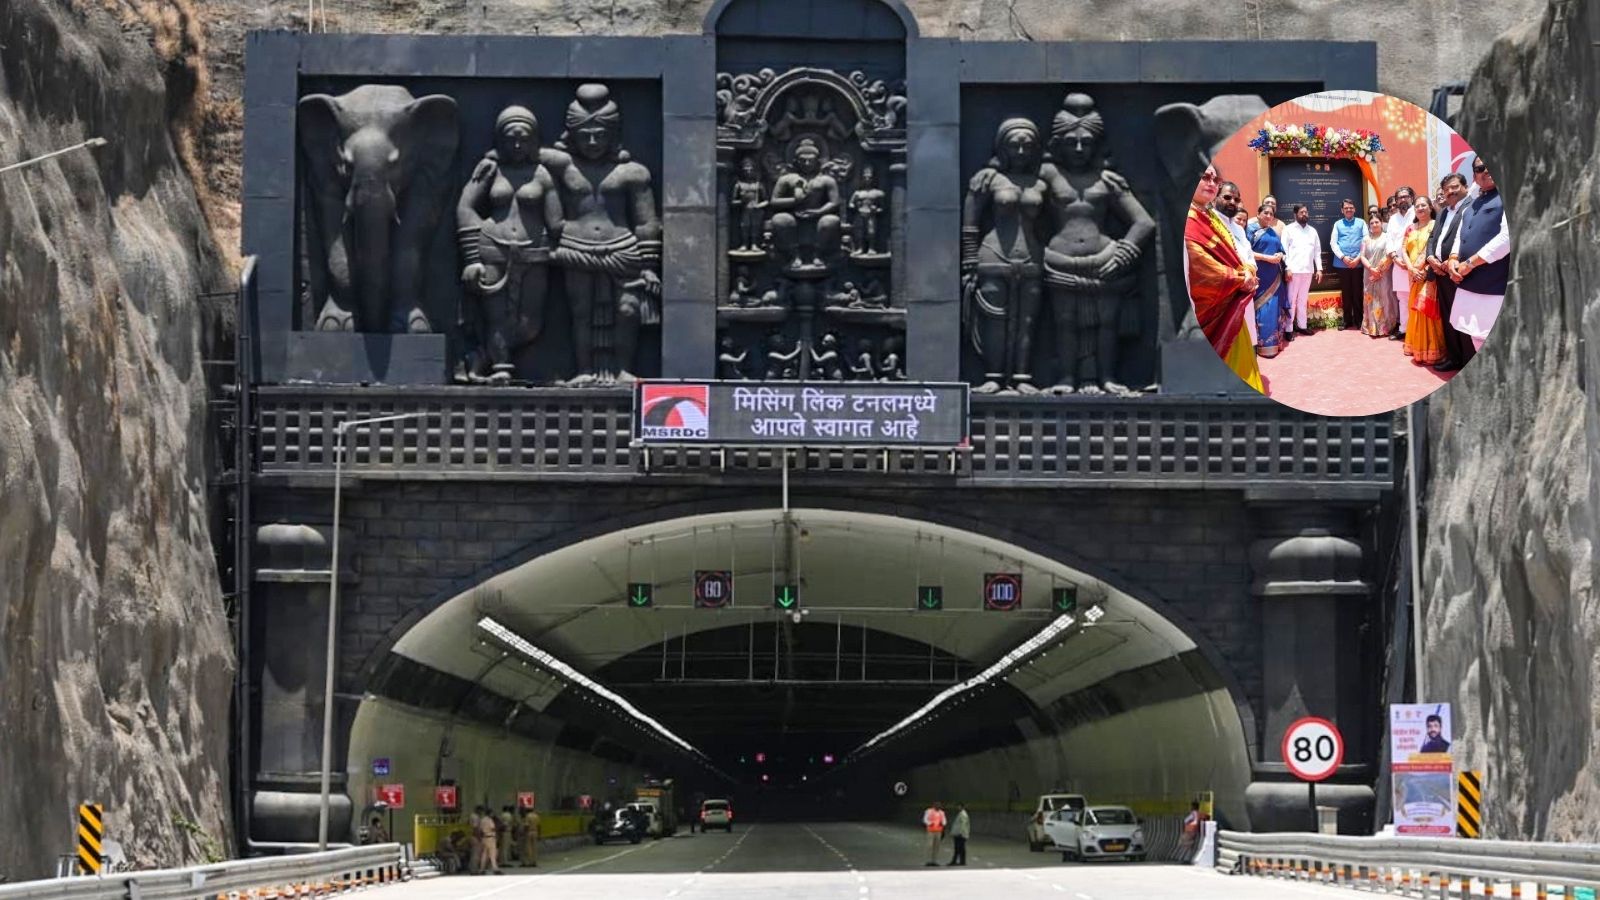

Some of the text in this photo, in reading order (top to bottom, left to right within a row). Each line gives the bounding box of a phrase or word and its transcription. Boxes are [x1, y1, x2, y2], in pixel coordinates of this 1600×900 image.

[733, 387, 937, 413] मिसिंग लिंक टनलमध्ये
[643, 428, 707, 437] MSRDC
[751, 412, 920, 439] आपले स्वागत आहे
[705, 581, 721, 598] 80
[992, 583, 1013, 600] 100
[1294, 735, 1335, 762] 80
